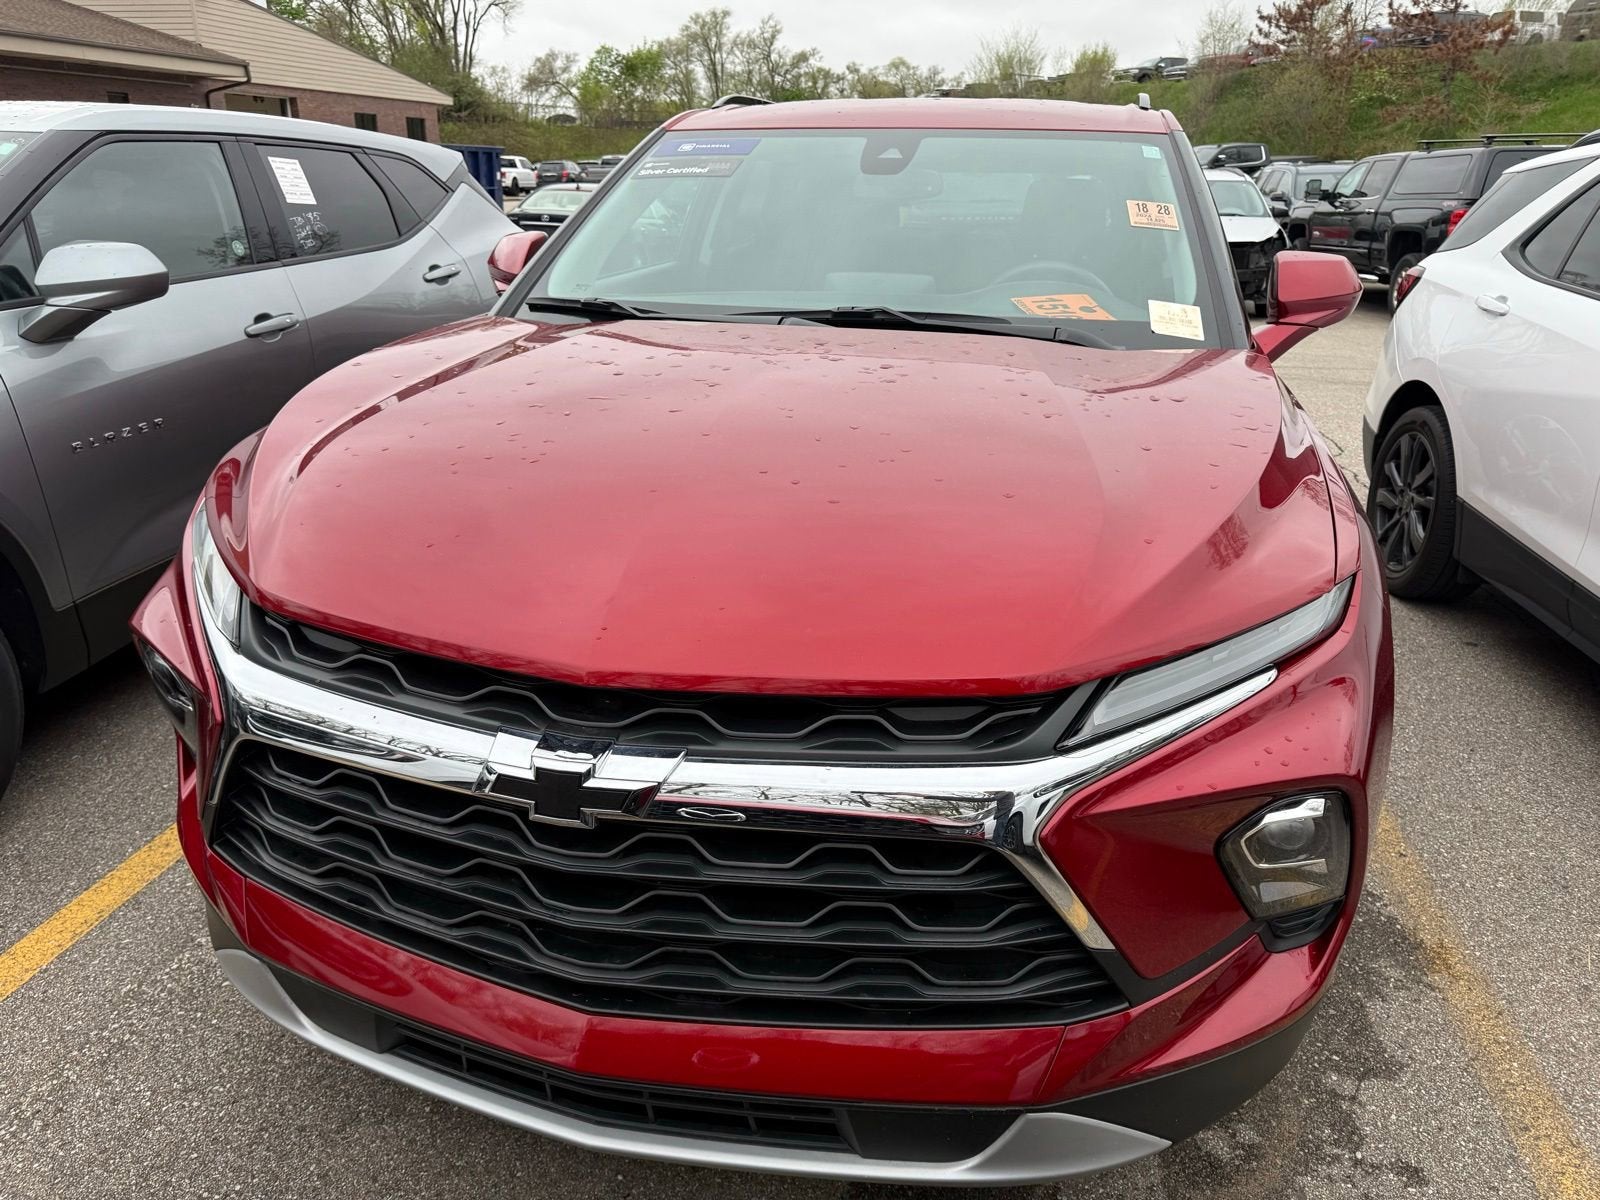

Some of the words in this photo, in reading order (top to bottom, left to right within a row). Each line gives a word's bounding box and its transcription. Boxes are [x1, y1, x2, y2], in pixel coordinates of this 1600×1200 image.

[638, 167, 665, 175] Silver
[1136, 203, 1149, 213] 18
[1156, 204, 1171, 215] 28
[71, 417, 164, 454] BLAZER
